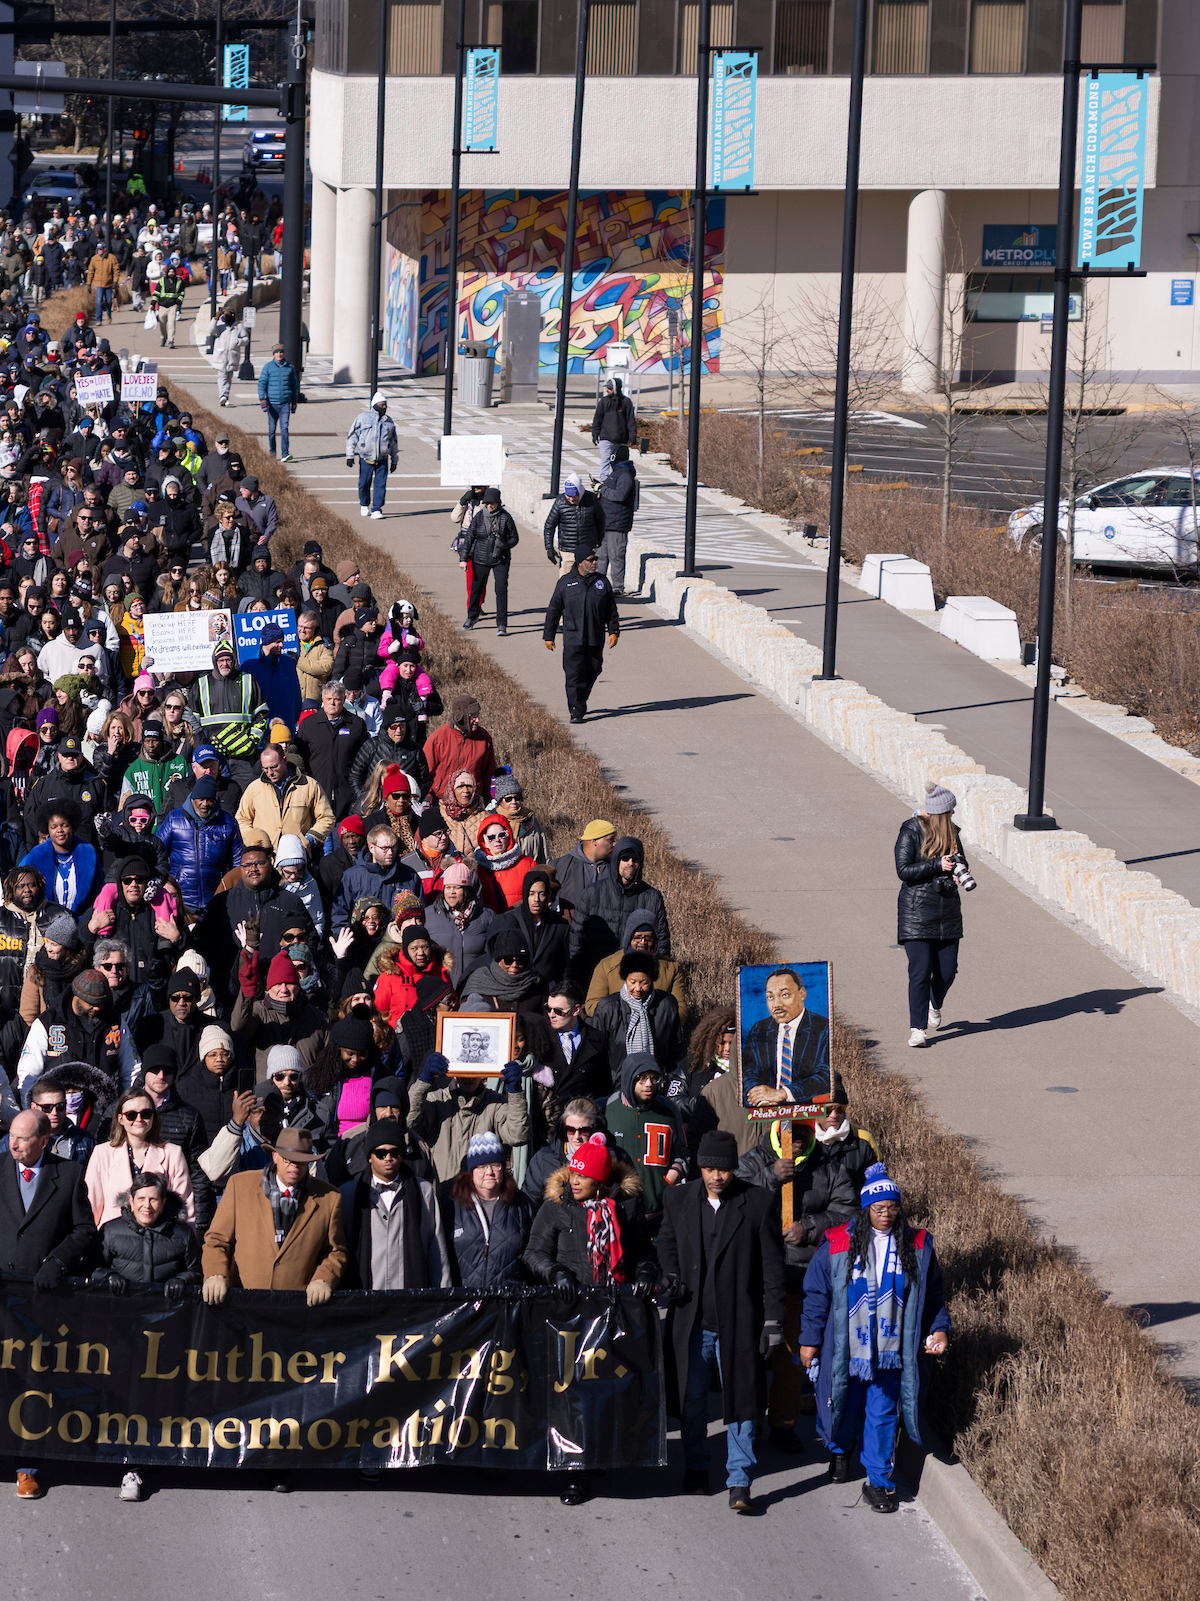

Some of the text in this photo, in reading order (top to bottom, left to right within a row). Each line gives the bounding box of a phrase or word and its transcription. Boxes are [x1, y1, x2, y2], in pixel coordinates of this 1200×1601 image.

[713, 59, 724, 183] TOWN BRANCH COMMONS
[1082, 82, 1099, 259] TOWN BRANCH COMMONS
[985, 248, 1057, 261] METROPLU
[76, 378, 90, 388] YES
[94, 375, 111, 386] LOVE
[124, 375, 155, 385] LOVE YES
[79, 392, 89, 400] NO
[95, 388, 111, 399] HATE
[241, 613, 290, 633] LOVE
[238, 636, 257, 647] One
[147, 645, 158, 654] My
[158, 644, 180, 653] dreams
[134, 771, 149, 782] PRAY
[137, 780, 149, 789] FOR
[752, 1104, 818, 1118] Peace On Earth
[643, 1122, 674, 1168] D
[140, 1330, 347, 1385] Luther
[374, 1333, 529, 1395] King,
[554, 1330, 629, 1393] Jr.
[8, 1389, 520, 1452] Commemoration
